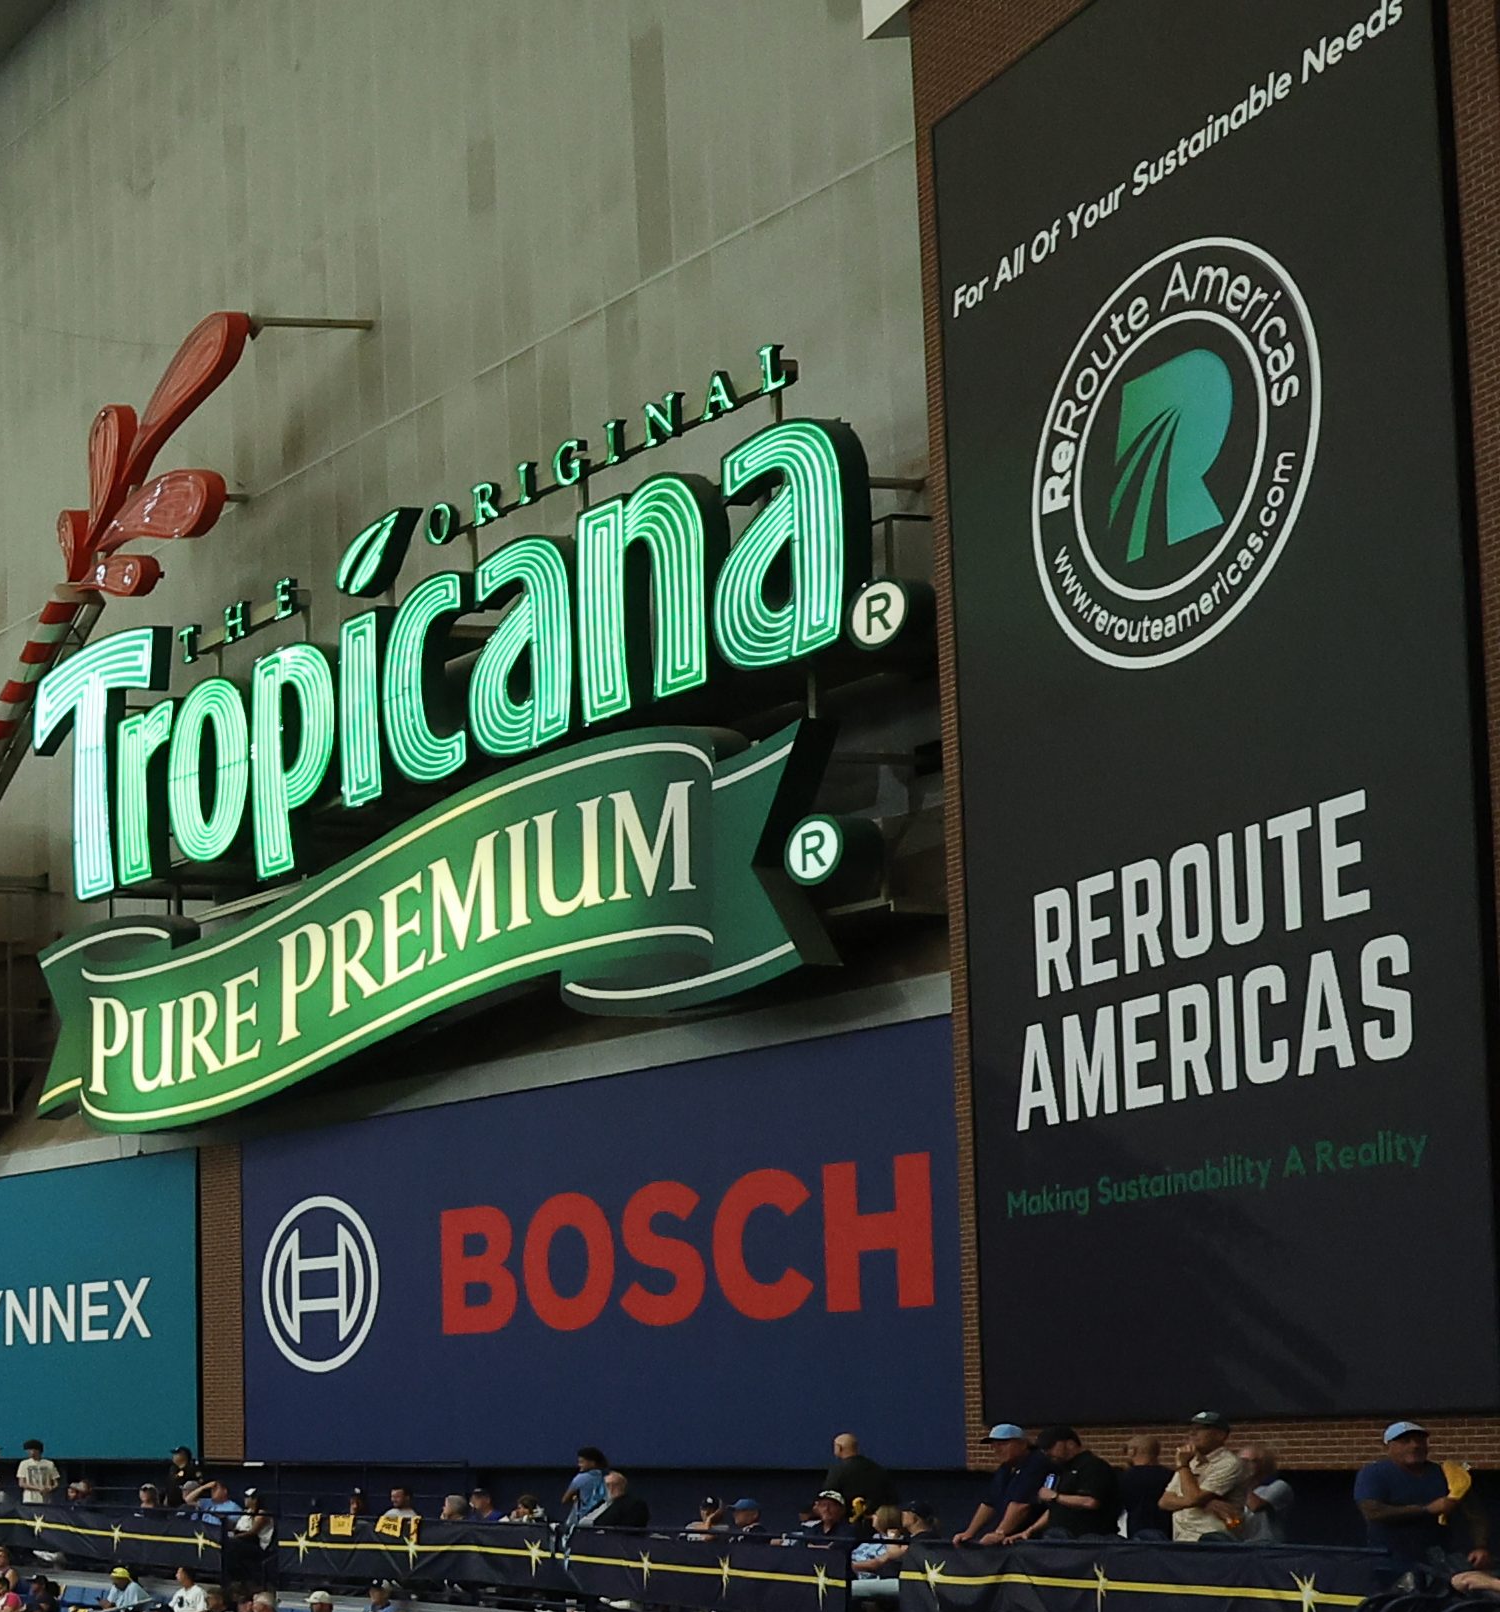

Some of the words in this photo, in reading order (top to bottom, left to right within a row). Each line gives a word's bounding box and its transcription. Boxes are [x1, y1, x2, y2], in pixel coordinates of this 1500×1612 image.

[952, 272, 990, 318] For
[994, 246, 1025, 291] All
[1030, 224, 1062, 265] Of
[1066, 179, 1127, 240] Your
[1132, 69, 1293, 198] Sustainable
[1301, 0, 1403, 84] Needs
[176, 576, 300, 666] THE
[422, 342, 799, 546] ORIGINAL
[1041, 295, 1150, 516] ReRoute
[1160, 261, 1299, 408] Americas
[33, 416, 871, 903] Tropicana
[1053, 450, 1297, 643] www.rerouteamericas.com
[88, 953, 260, 1097] PURE
[275, 777, 697, 1046] PREMIUM
[1033, 788, 1371, 998] REROUTE
[1016, 934, 1413, 1131] AMERICAS
[439, 1151, 935, 1337] BOSCH
[1007, 1183, 1090, 1218] Making
[1097, 1155, 1272, 1206] Sustainability
[1283, 1146, 1306, 1177] A
[1316, 1130, 1428, 1173] Reality
